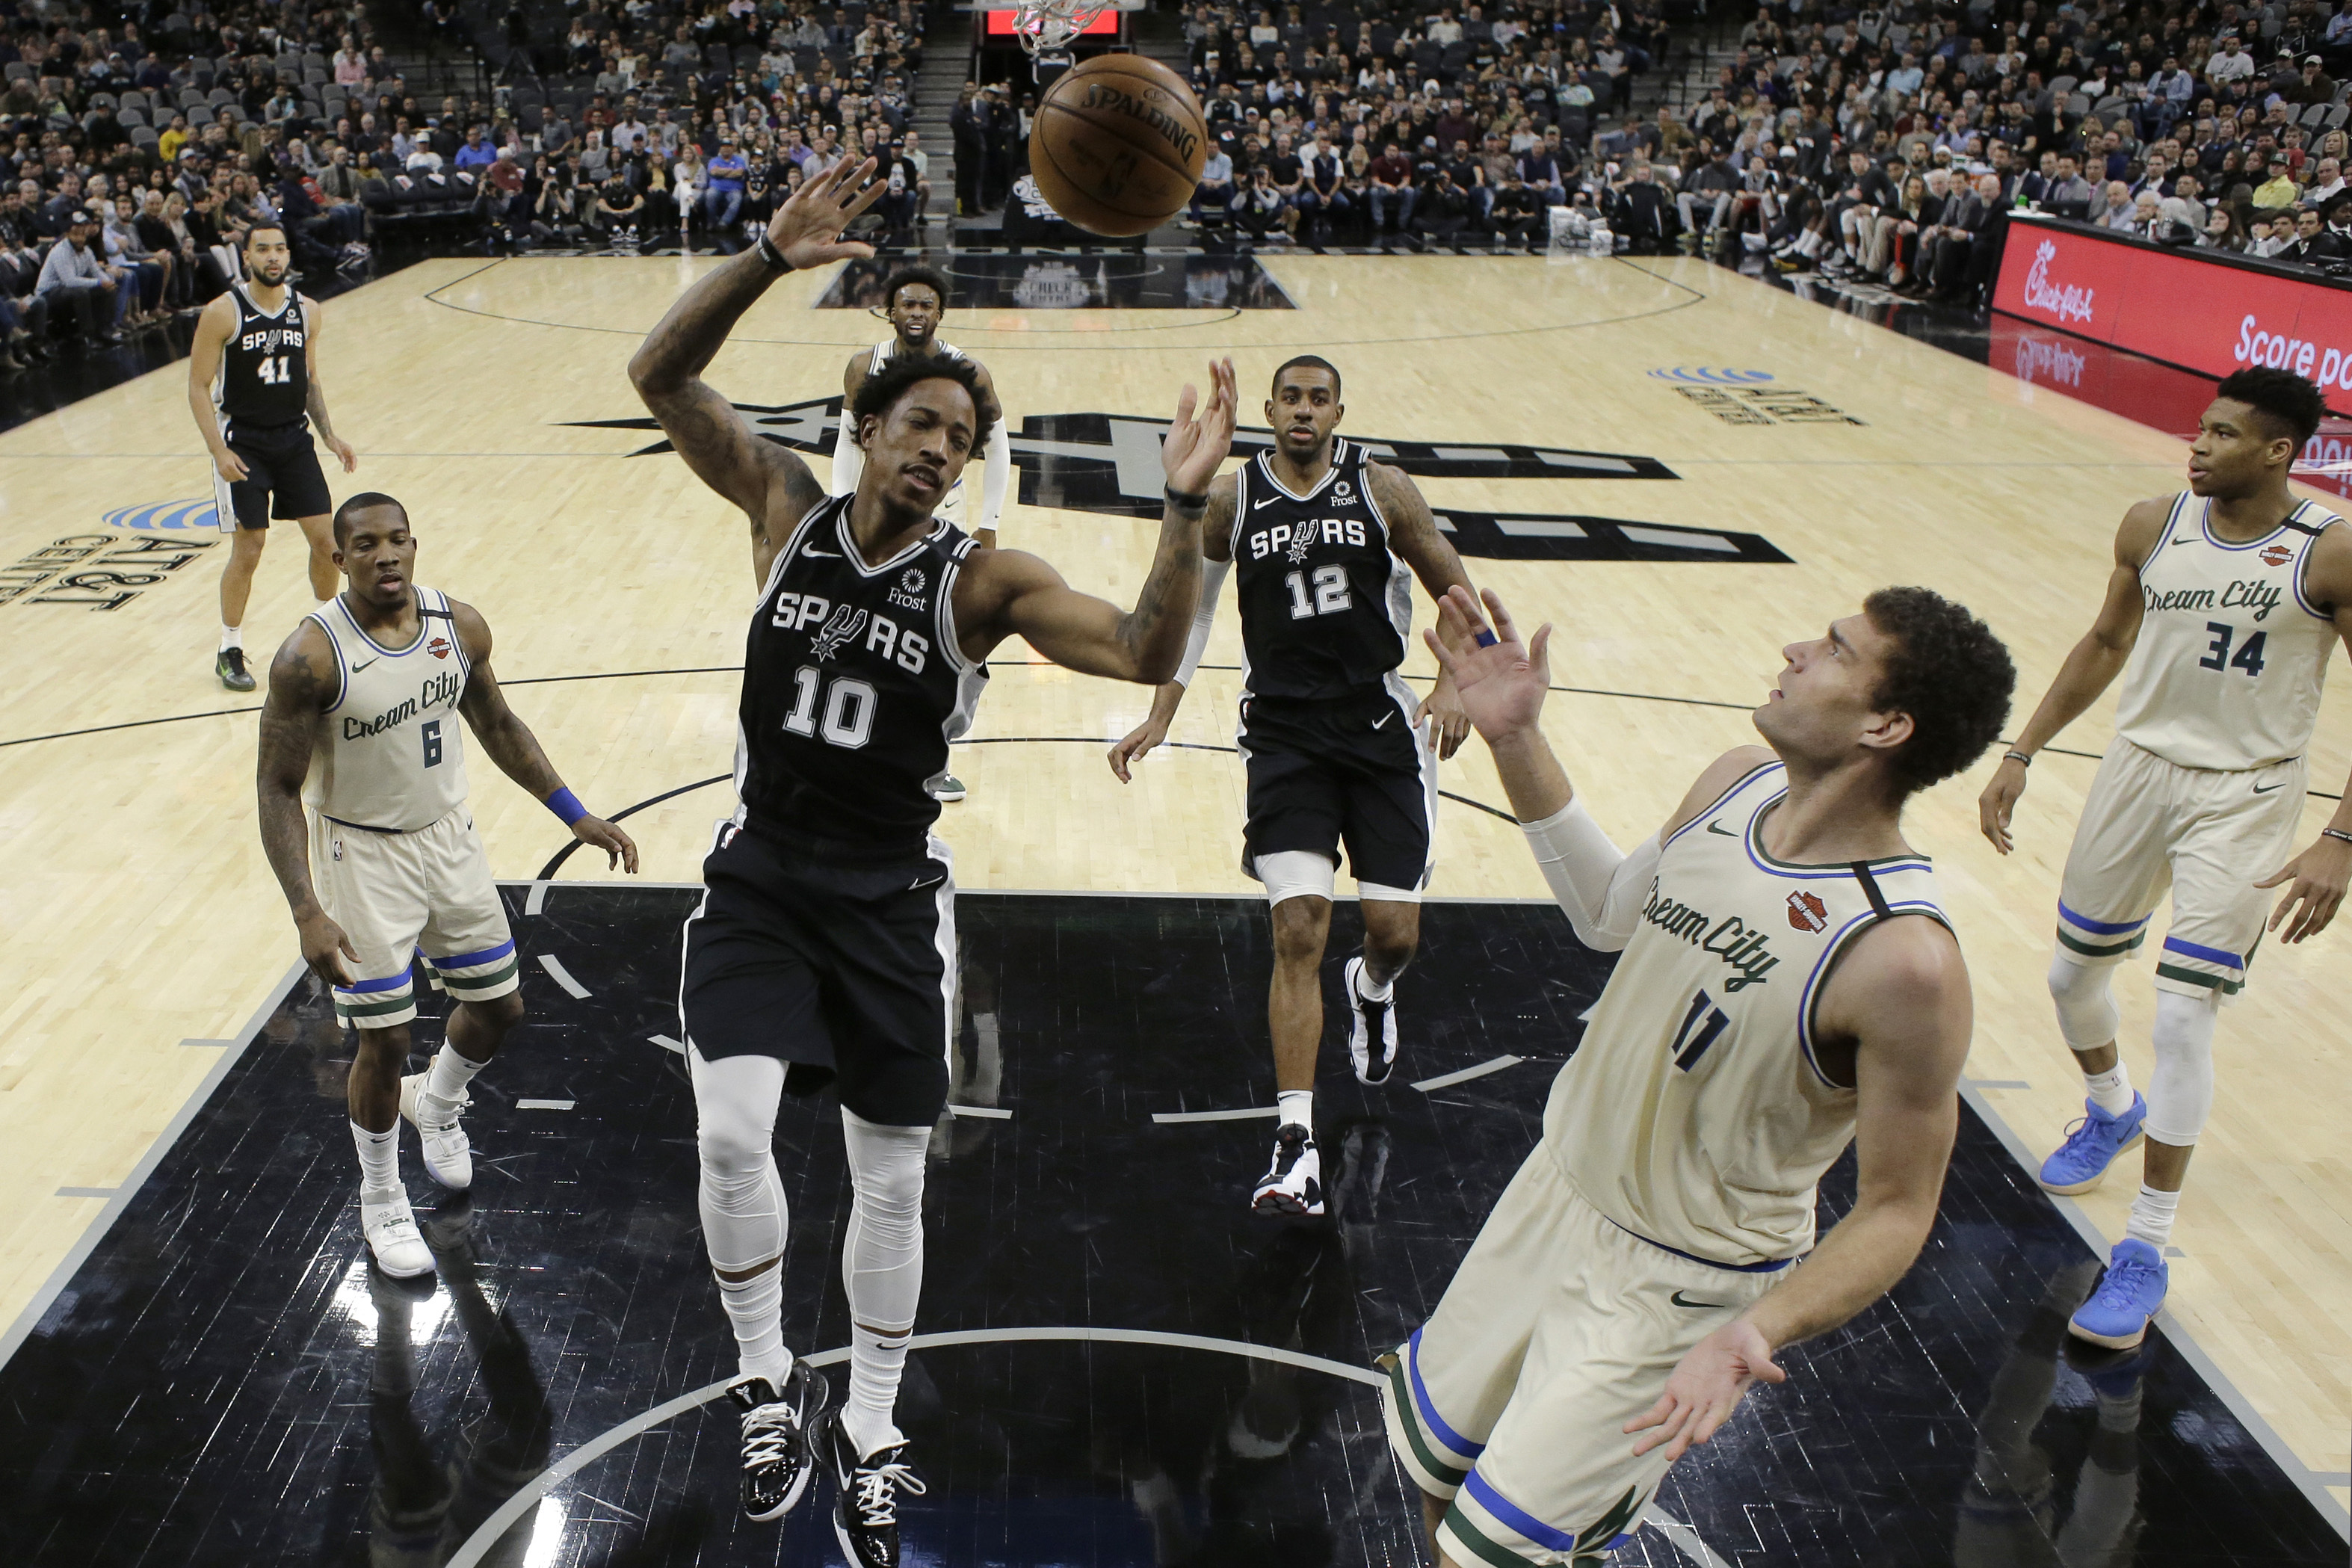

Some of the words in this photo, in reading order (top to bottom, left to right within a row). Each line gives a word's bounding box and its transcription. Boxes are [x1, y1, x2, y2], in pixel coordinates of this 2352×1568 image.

[1081, 84, 1197, 166] SPALDING
[241, 329, 303, 351] SPURS
[2234, 314, 2315, 378] Score
[257, 356, 291, 385] 41
[1330, 495, 1358, 507] Frost
[0, 535, 119, 606] CENT
[1250, 519, 1366, 562] SPURS
[21, 535, 221, 611] AT&T
[887, 587, 926, 612] Frost
[1285, 563, 1353, 620] 12
[2143, 584, 2216, 613] Cream
[2220, 580, 2282, 623] City
[772, 592, 930, 675] SPURS
[2199, 621, 2268, 677] 34
[344, 697, 418, 741] Cream
[422, 671, 460, 709] City
[782, 664, 878, 750] 10
[422, 720, 442, 768] 6
[1703, 916, 1780, 993] City
[1670, 988, 1730, 1073] 11
